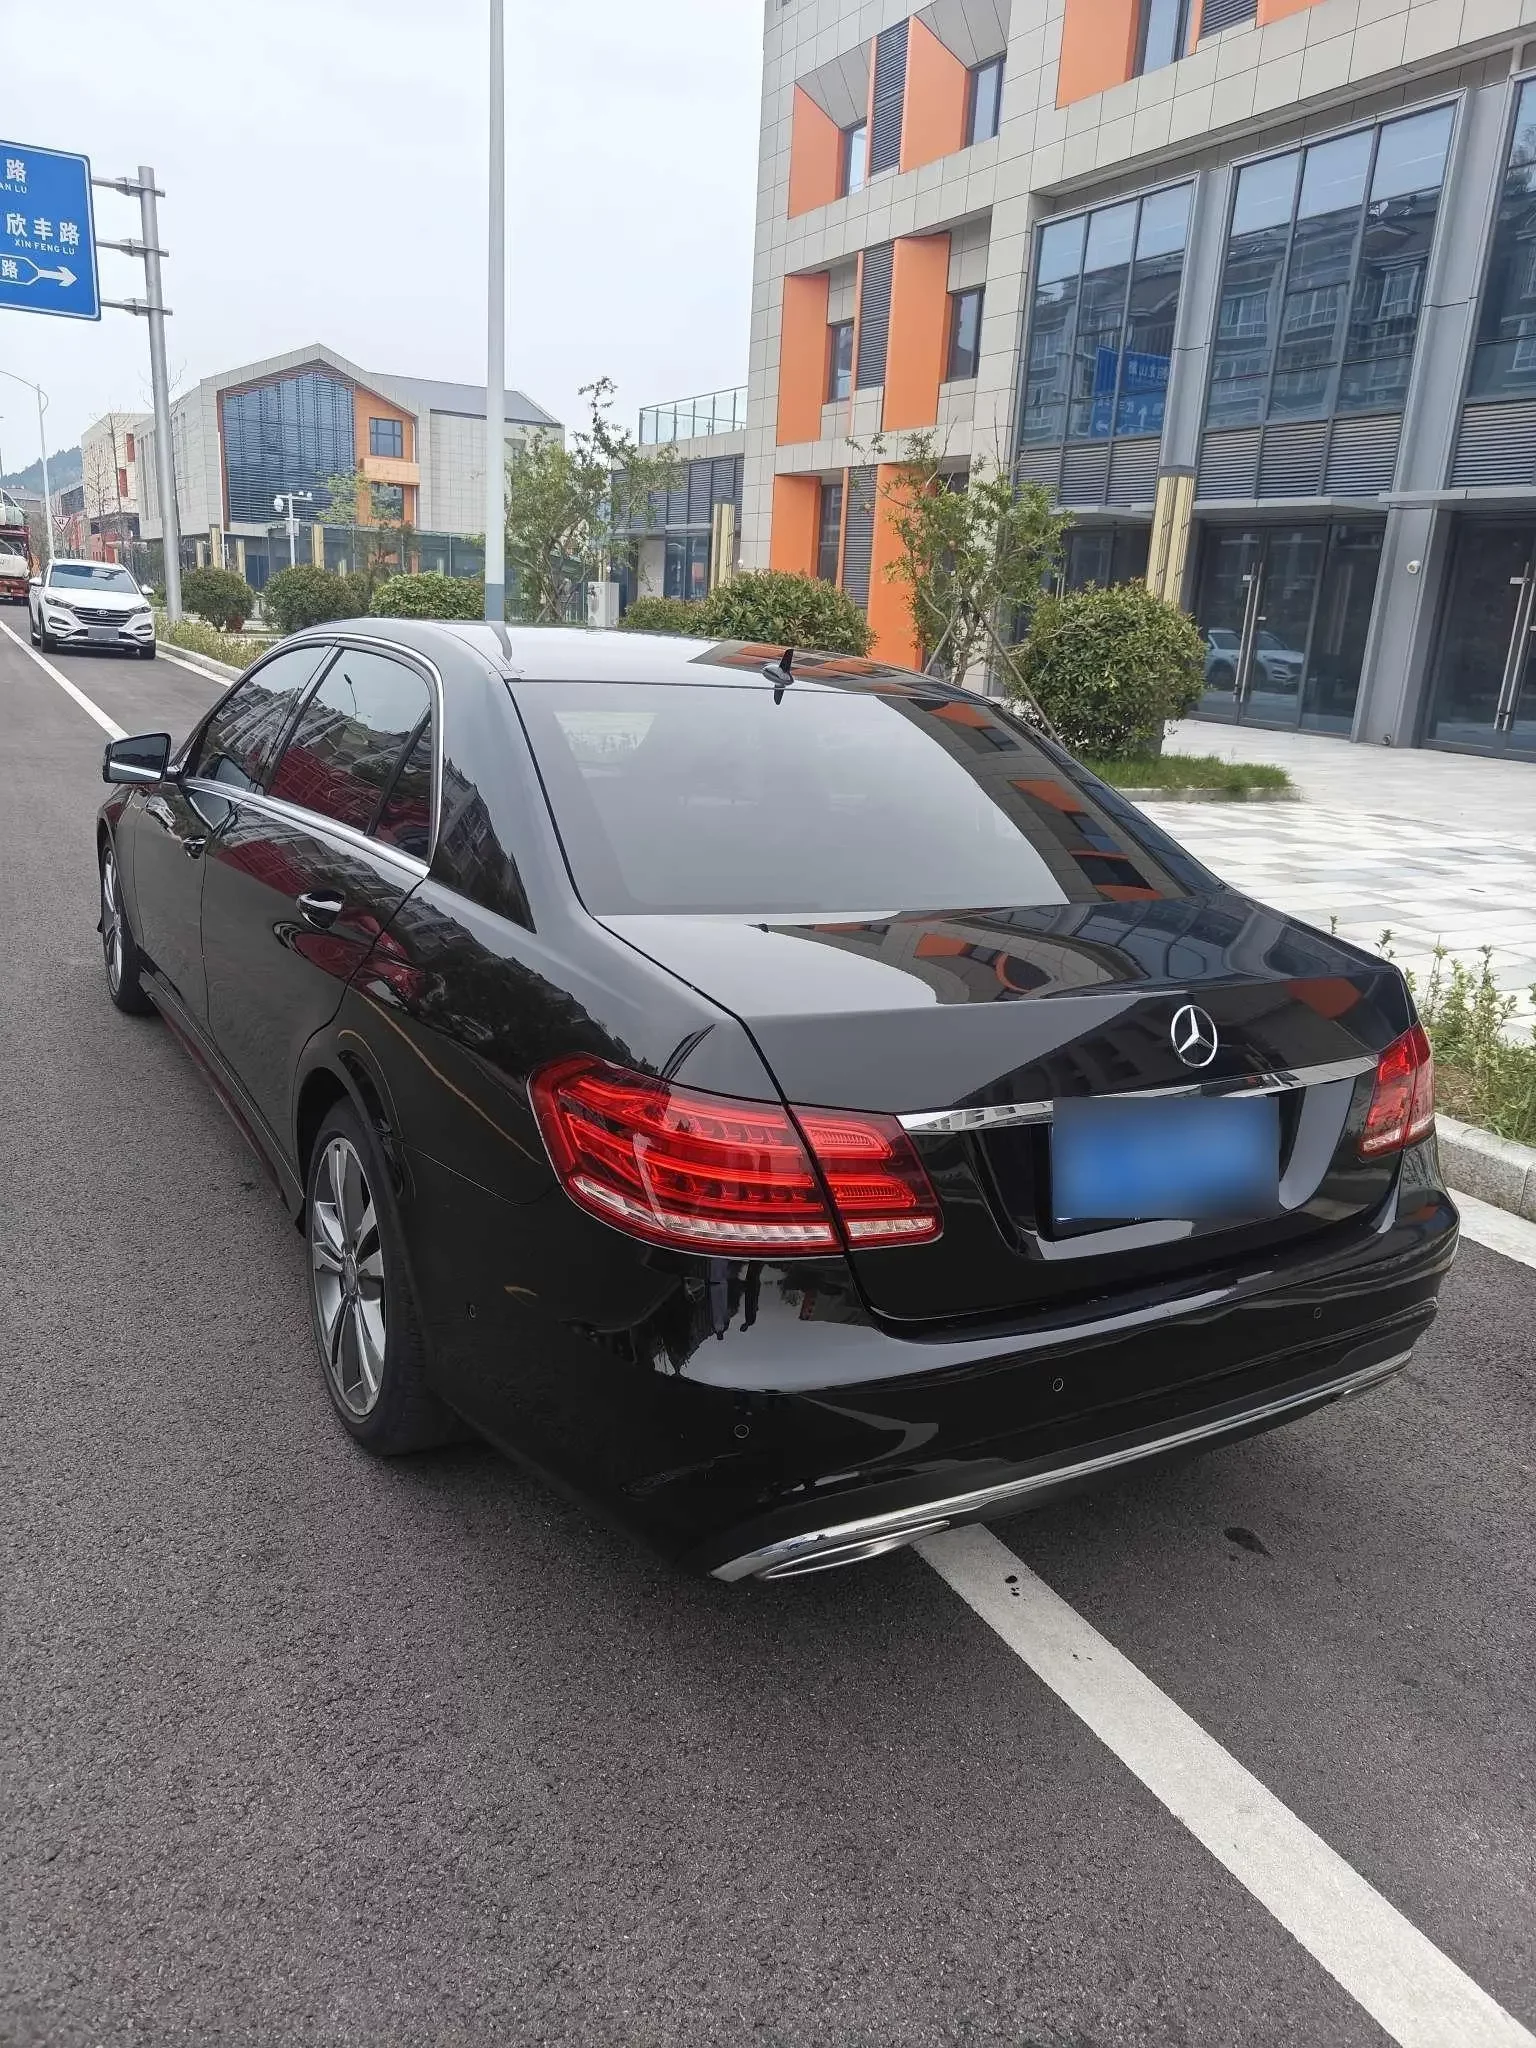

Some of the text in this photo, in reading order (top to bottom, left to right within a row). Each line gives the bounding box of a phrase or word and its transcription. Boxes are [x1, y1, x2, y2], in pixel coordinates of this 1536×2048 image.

[7, 159, 26, 184] 路
[15, 185, 27, 194] LU
[6, 212, 80, 247] 欣丰路
[15, 239, 75, 255] XIN FENG LU
[2, 259, 18, 280] 路
